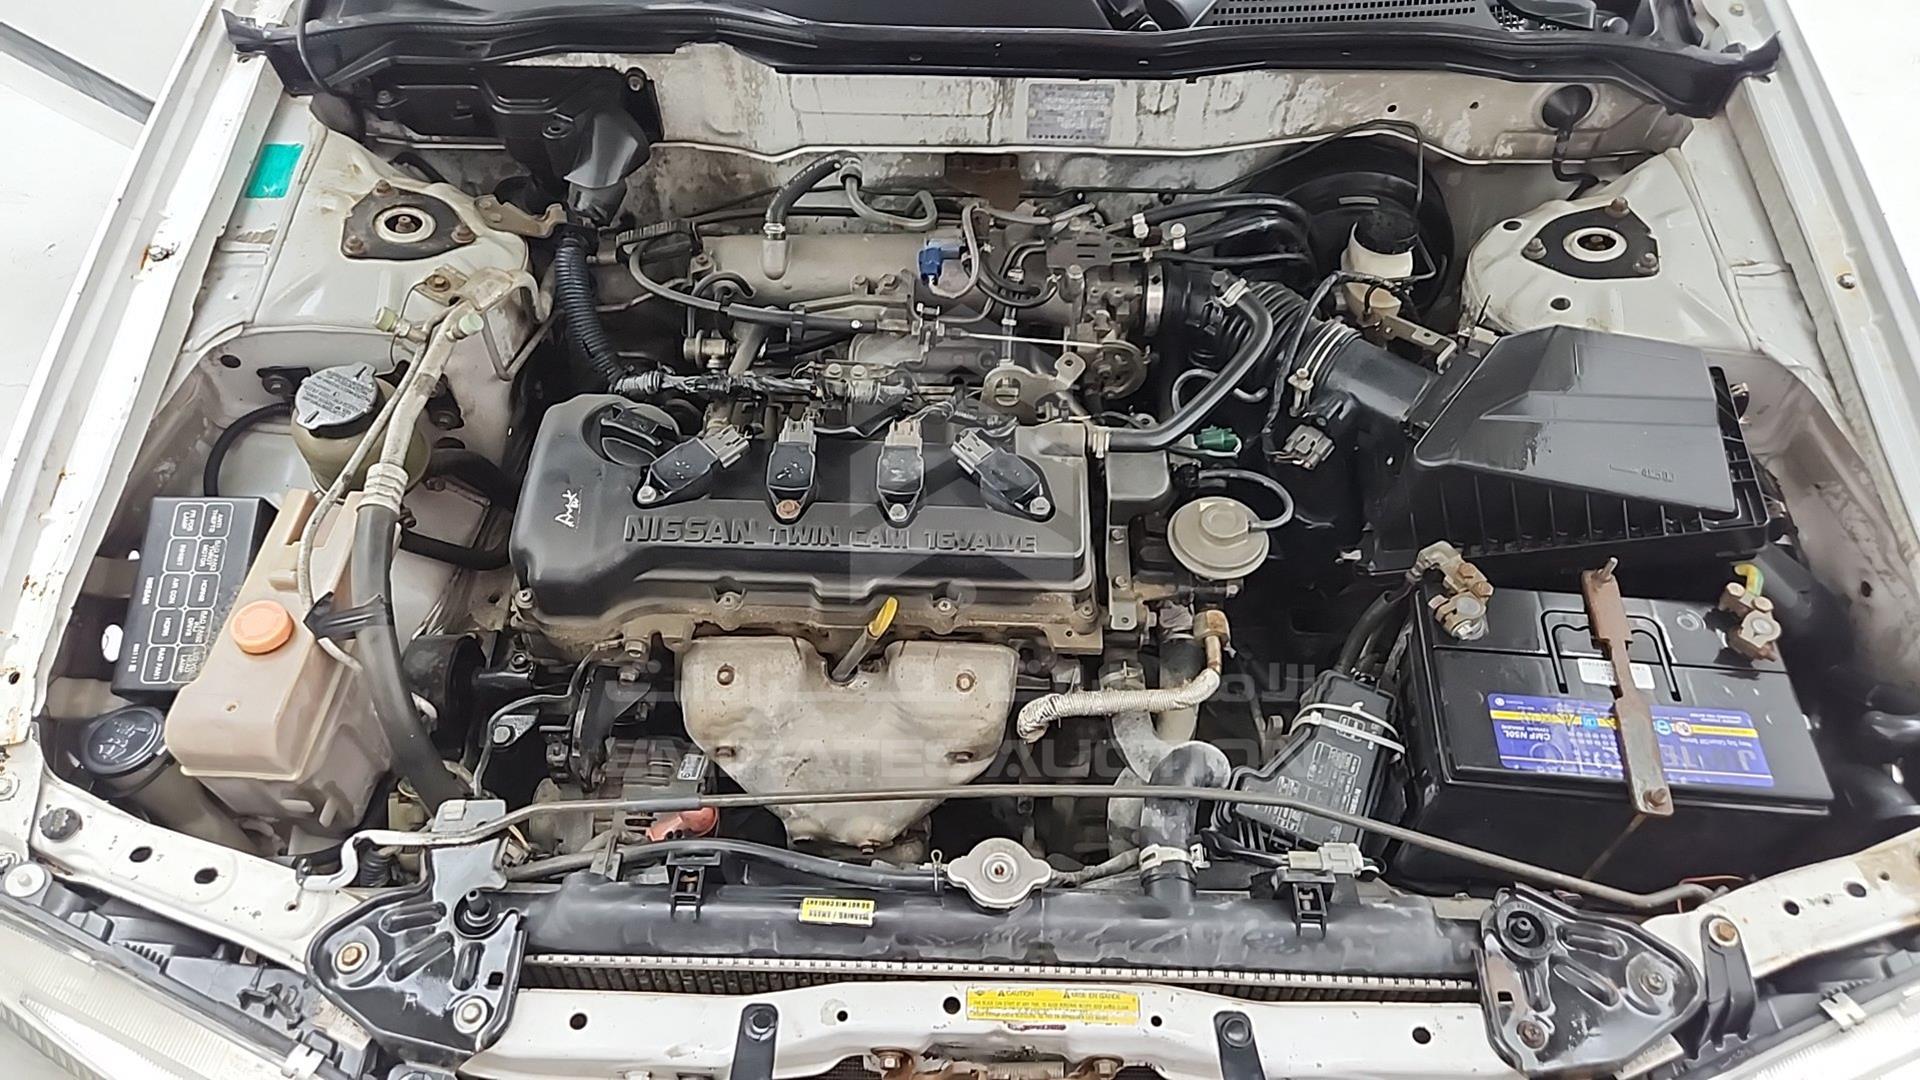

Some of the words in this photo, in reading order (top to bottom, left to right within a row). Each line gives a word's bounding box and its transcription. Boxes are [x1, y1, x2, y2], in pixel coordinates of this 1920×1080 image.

[623, 514, 755, 544] NISSAN
[769, 525, 840, 547] TWIN
[849, 527, 911, 549] CAM
[924, 529, 1037, 553] 16VALVE
[170, 577, 180, 589] AIR
[157, 647, 167, 662] RAD
[1006, 990, 1035, 998] CAUTION
